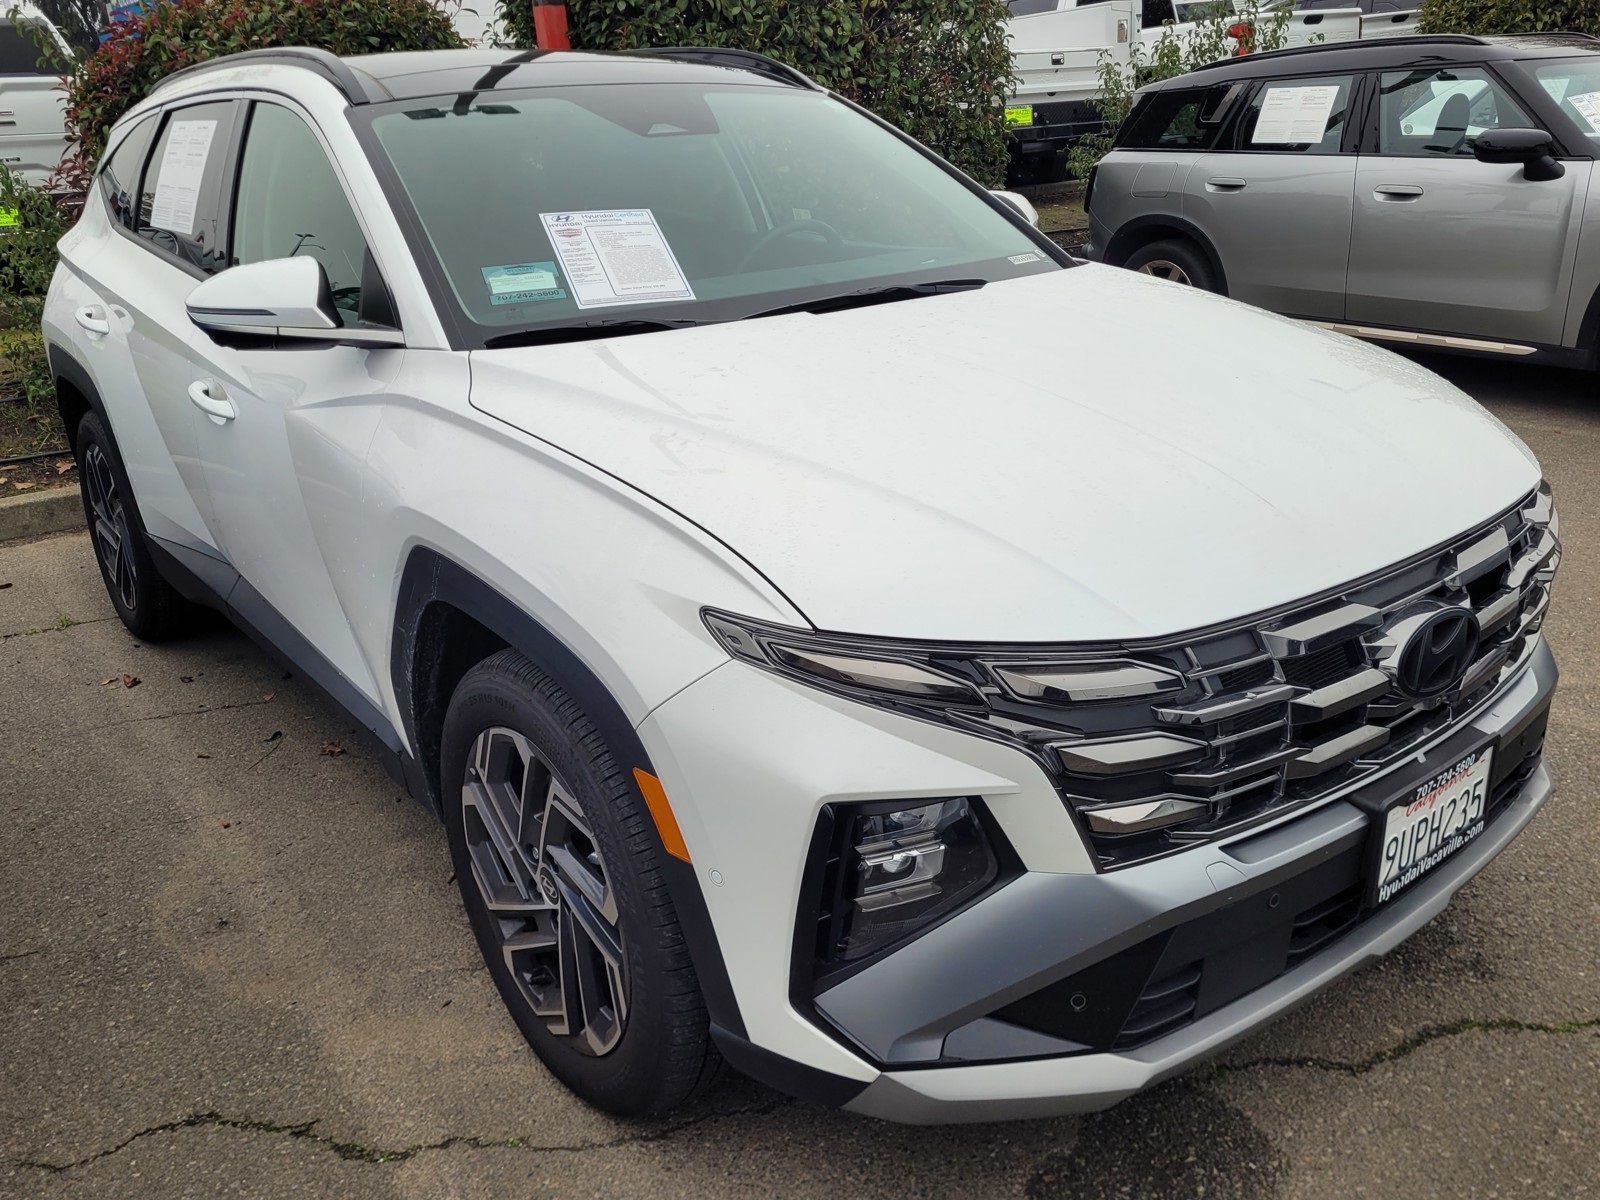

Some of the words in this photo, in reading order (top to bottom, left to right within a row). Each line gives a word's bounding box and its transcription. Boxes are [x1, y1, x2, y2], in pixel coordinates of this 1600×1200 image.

[581, 213, 614, 221] Hyundai
[495, 289, 560, 301] 707-242-5600
[1416, 753, 1476, 801] 707-724-5600
[1382, 777, 1485, 885] 9UPH235
[1378, 820, 1485, 903] HyundaiVacaville.com
